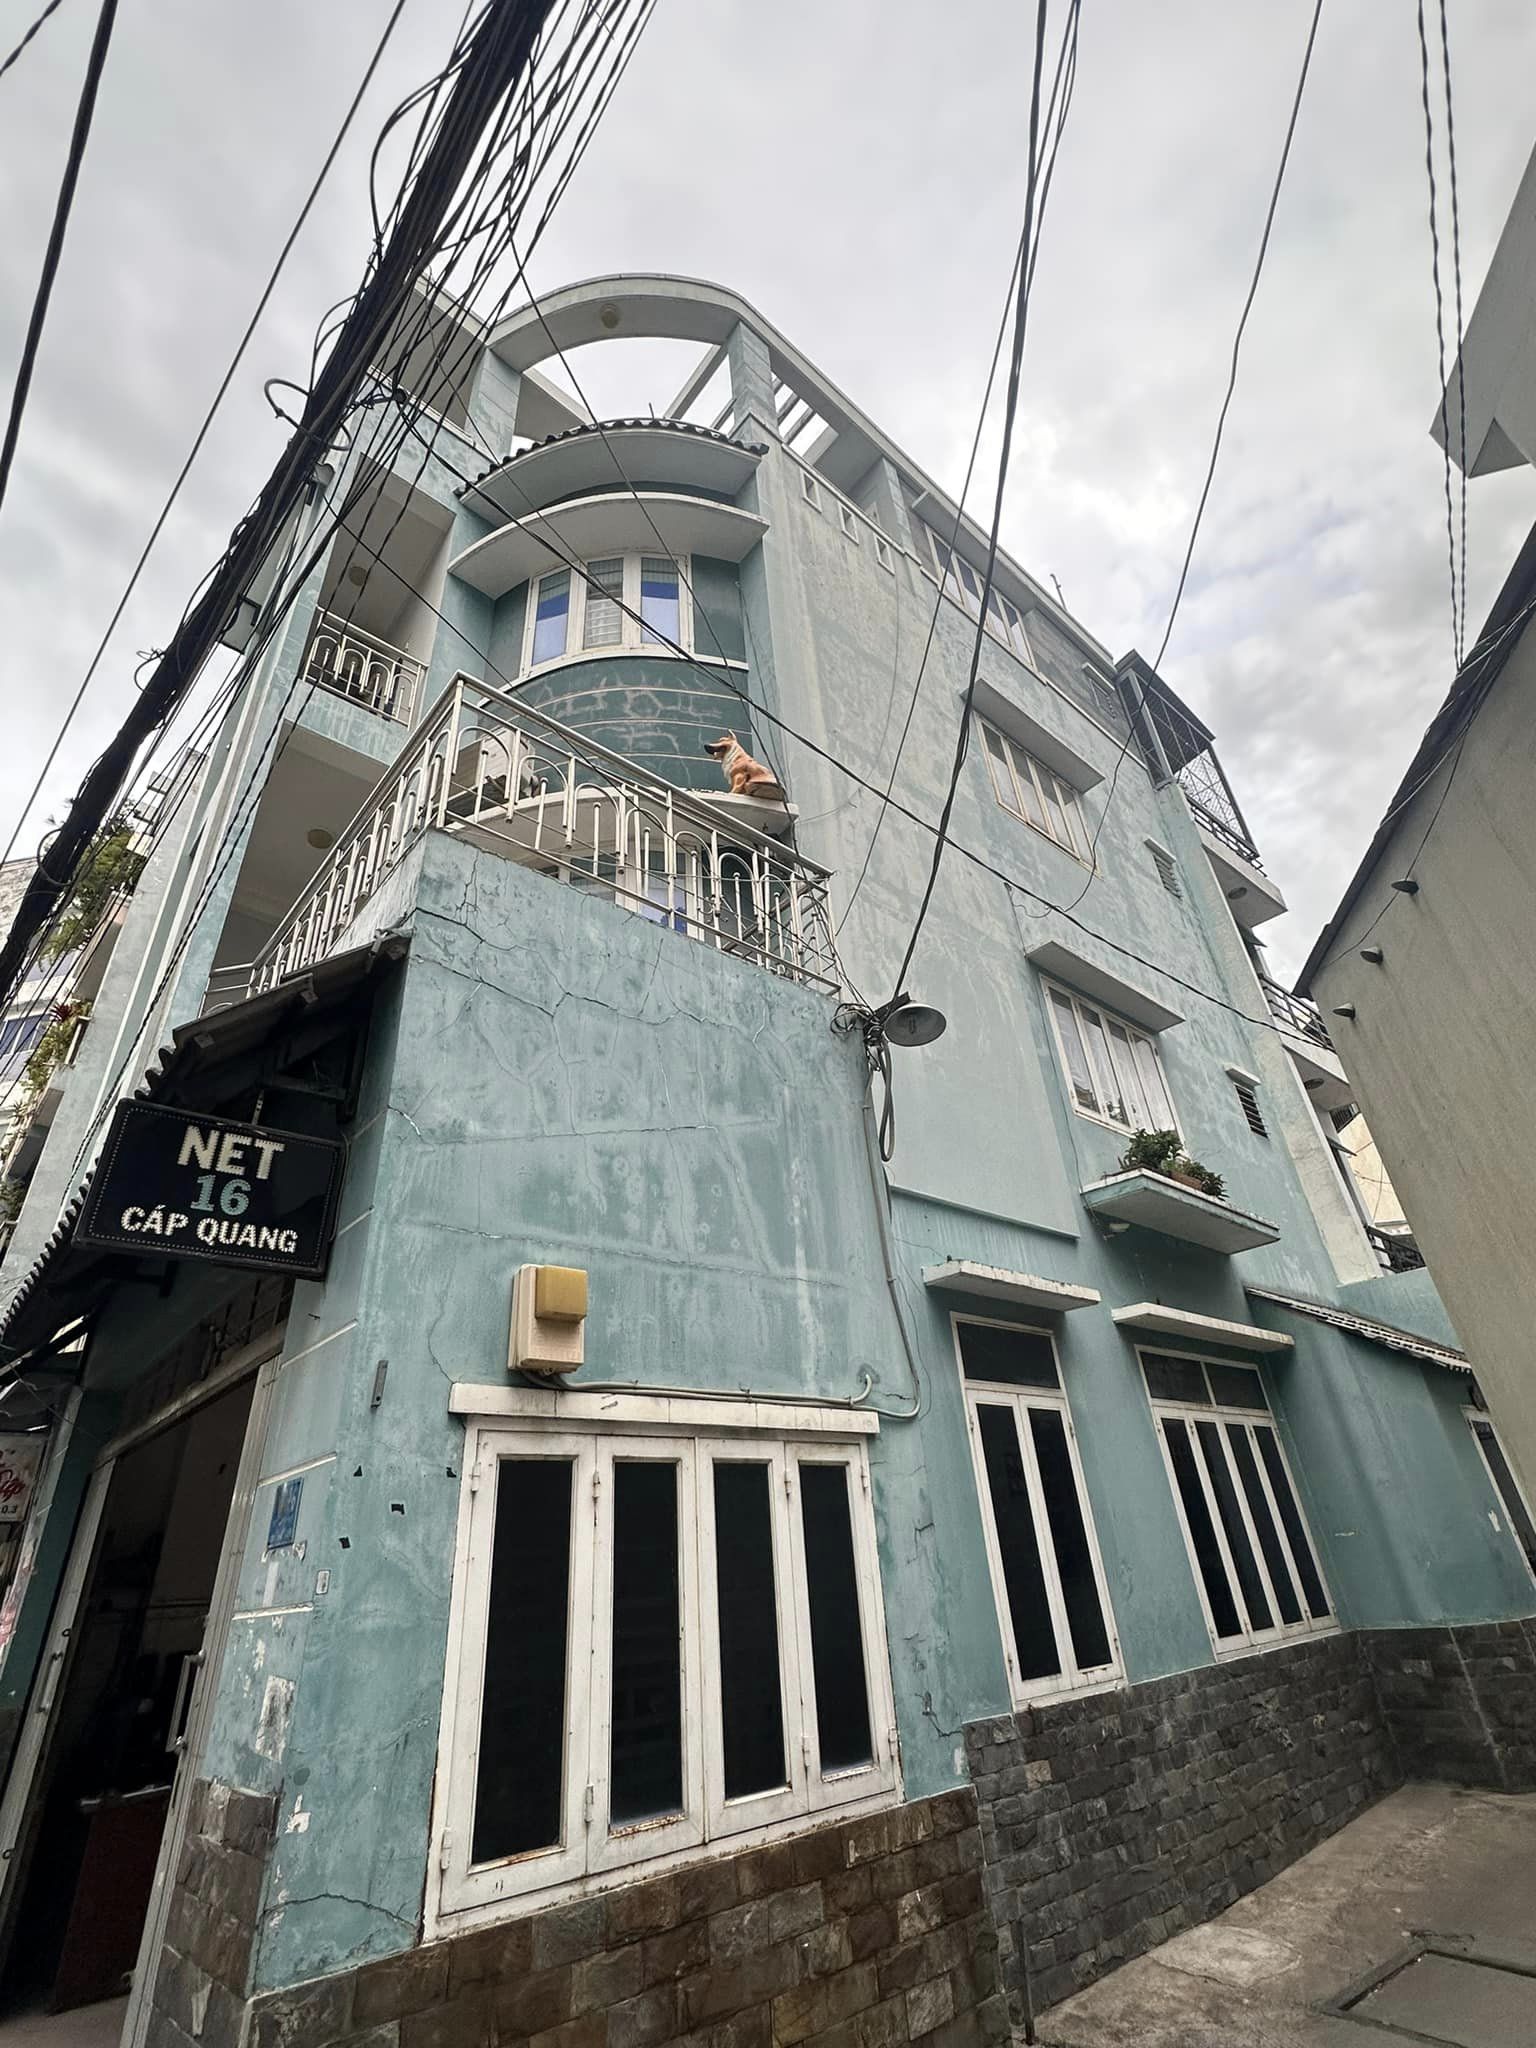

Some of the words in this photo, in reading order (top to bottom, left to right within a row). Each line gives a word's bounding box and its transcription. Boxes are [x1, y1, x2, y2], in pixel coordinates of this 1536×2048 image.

[177, 1125, 285, 1180] NET
[190, 1174, 252, 1216] 16
[121, 1205, 190, 1237] CÁP
[196, 1217, 299, 1253] QUANG
